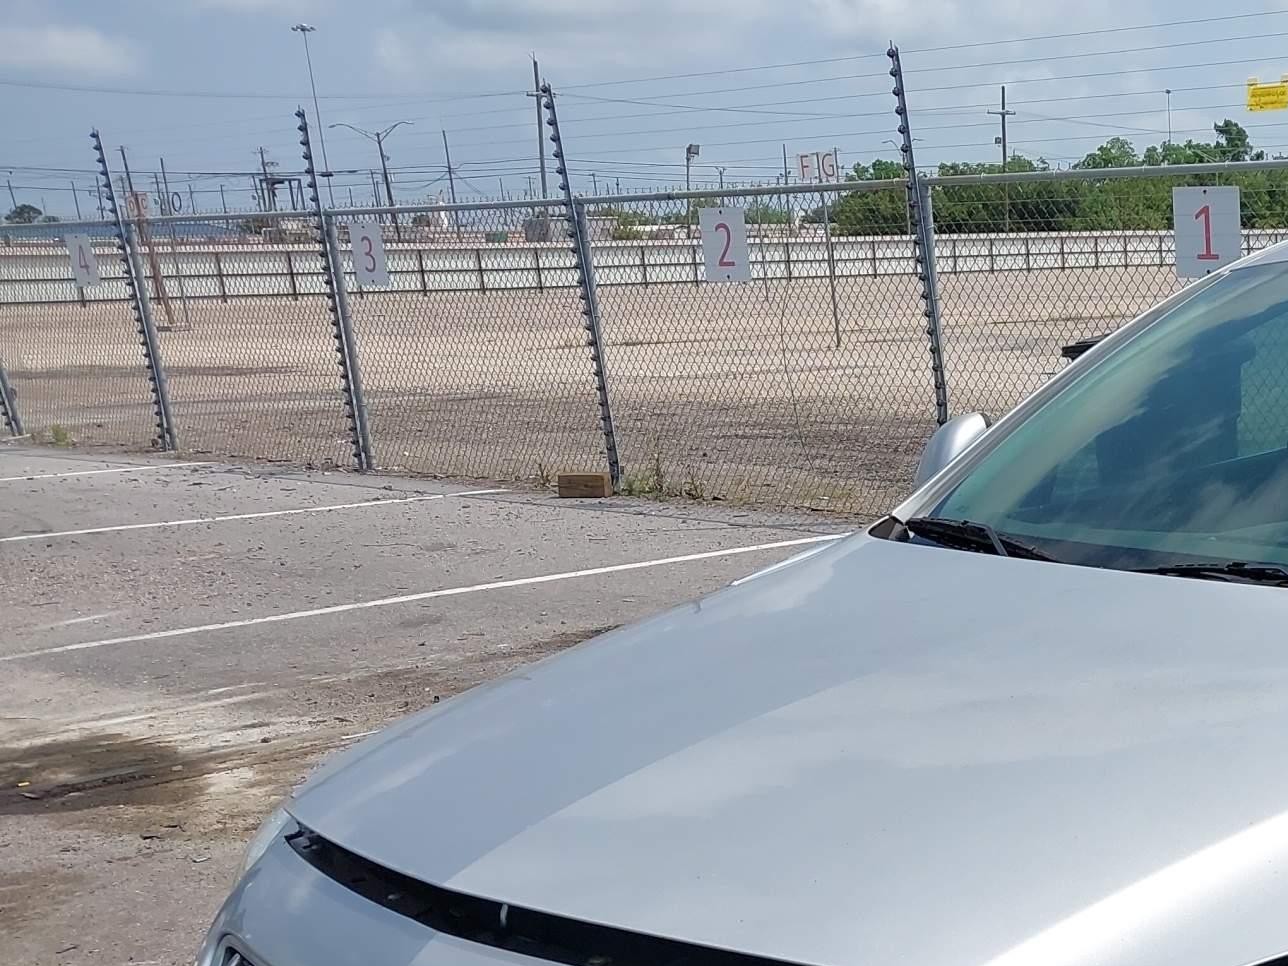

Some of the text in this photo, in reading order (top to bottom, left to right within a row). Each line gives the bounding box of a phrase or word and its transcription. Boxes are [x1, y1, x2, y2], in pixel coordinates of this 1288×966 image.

[800, 155, 809, 177] F
[822, 153, 835, 177] G
[714, 222, 736, 267] 2
[1194, 205, 1220, 260] 1
[78, 245, 90, 275] 4
[361, 236, 376, 272] 3
